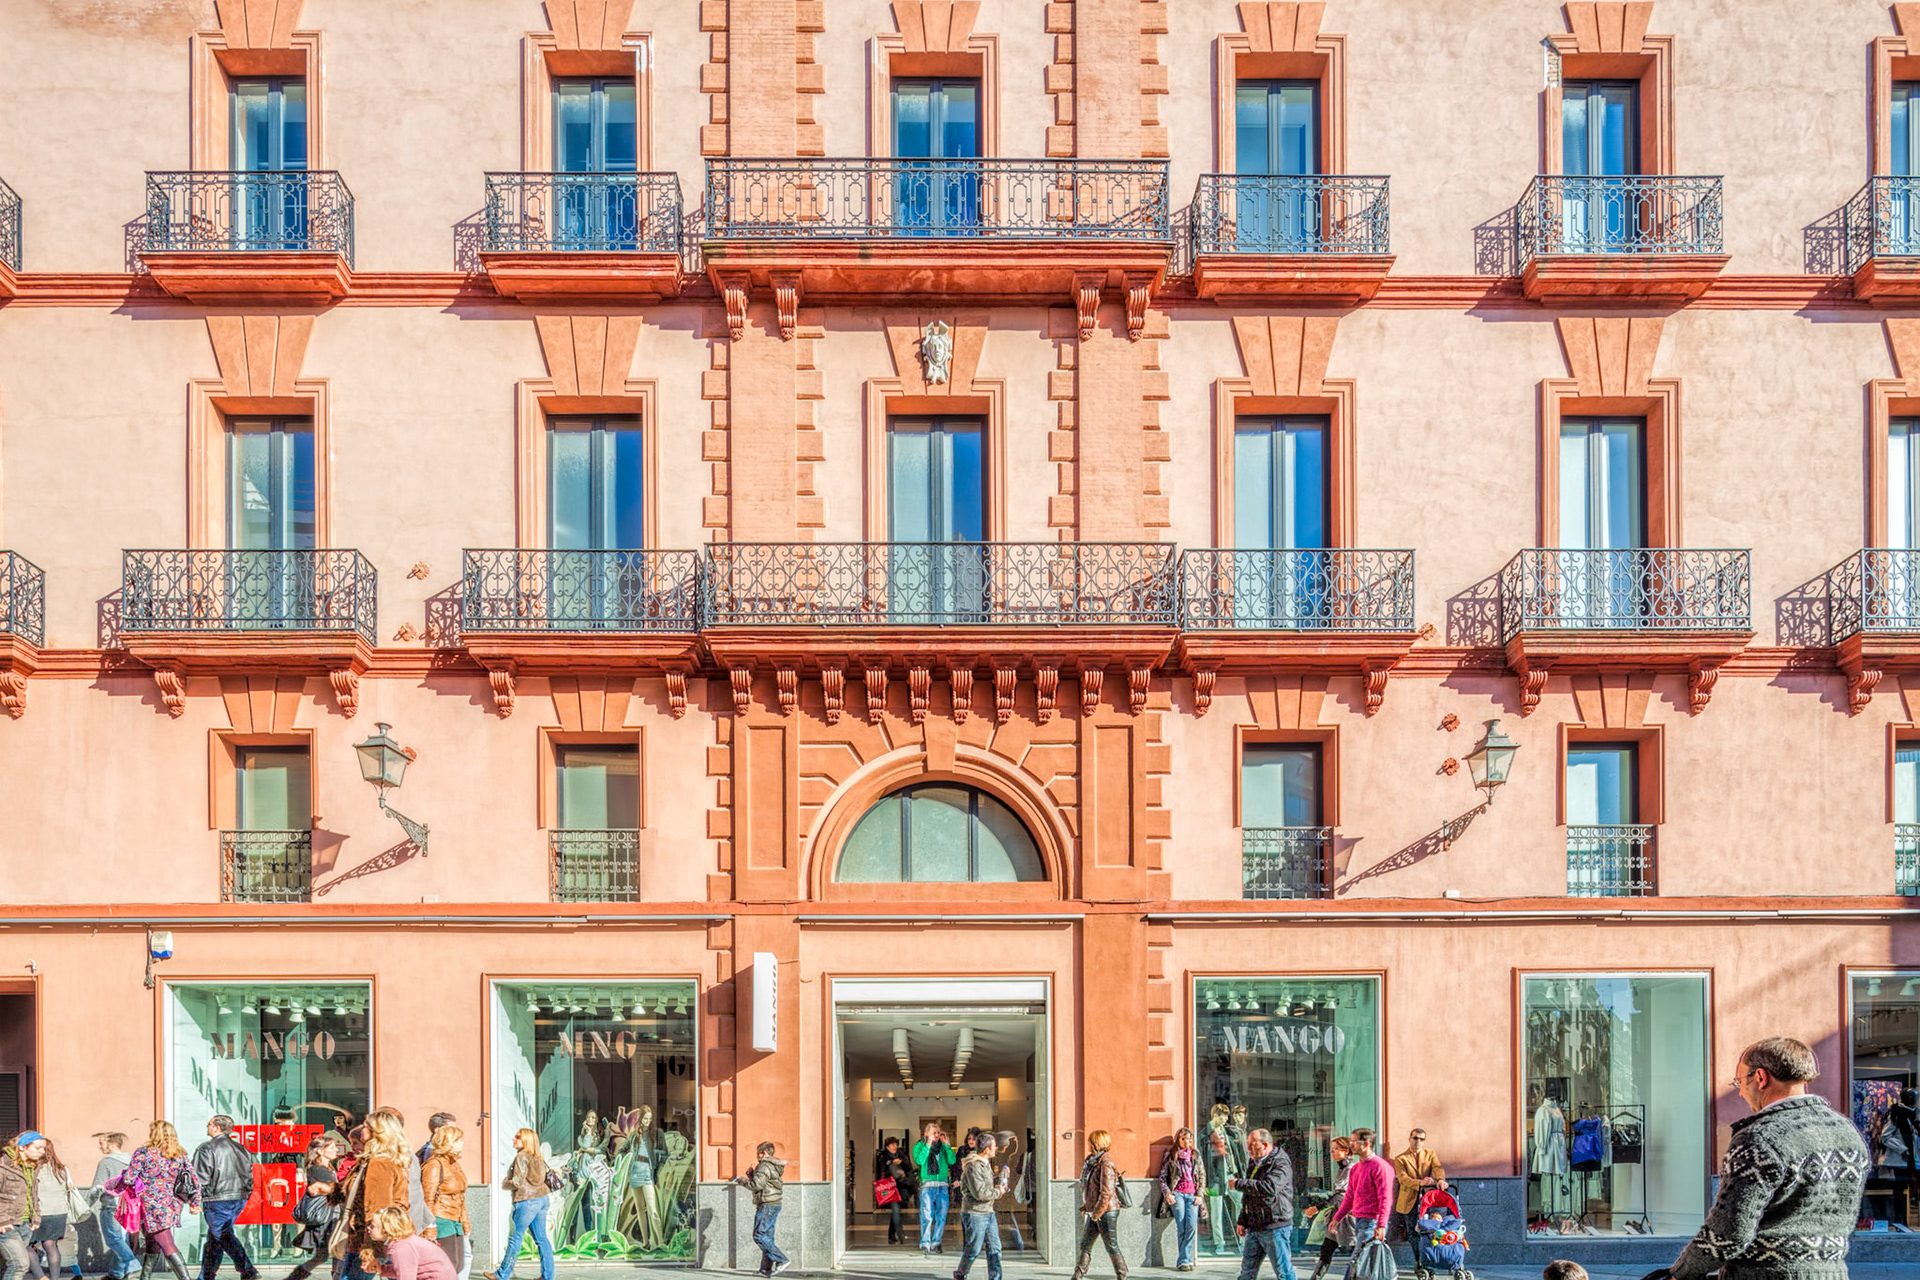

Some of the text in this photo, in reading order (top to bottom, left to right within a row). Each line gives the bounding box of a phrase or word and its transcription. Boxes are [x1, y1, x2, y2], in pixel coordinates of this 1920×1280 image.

[210, 1031, 335, 1060] MANGO
[558, 1031, 637, 1060] MNG
[1223, 1025, 1345, 1054] MANGO
